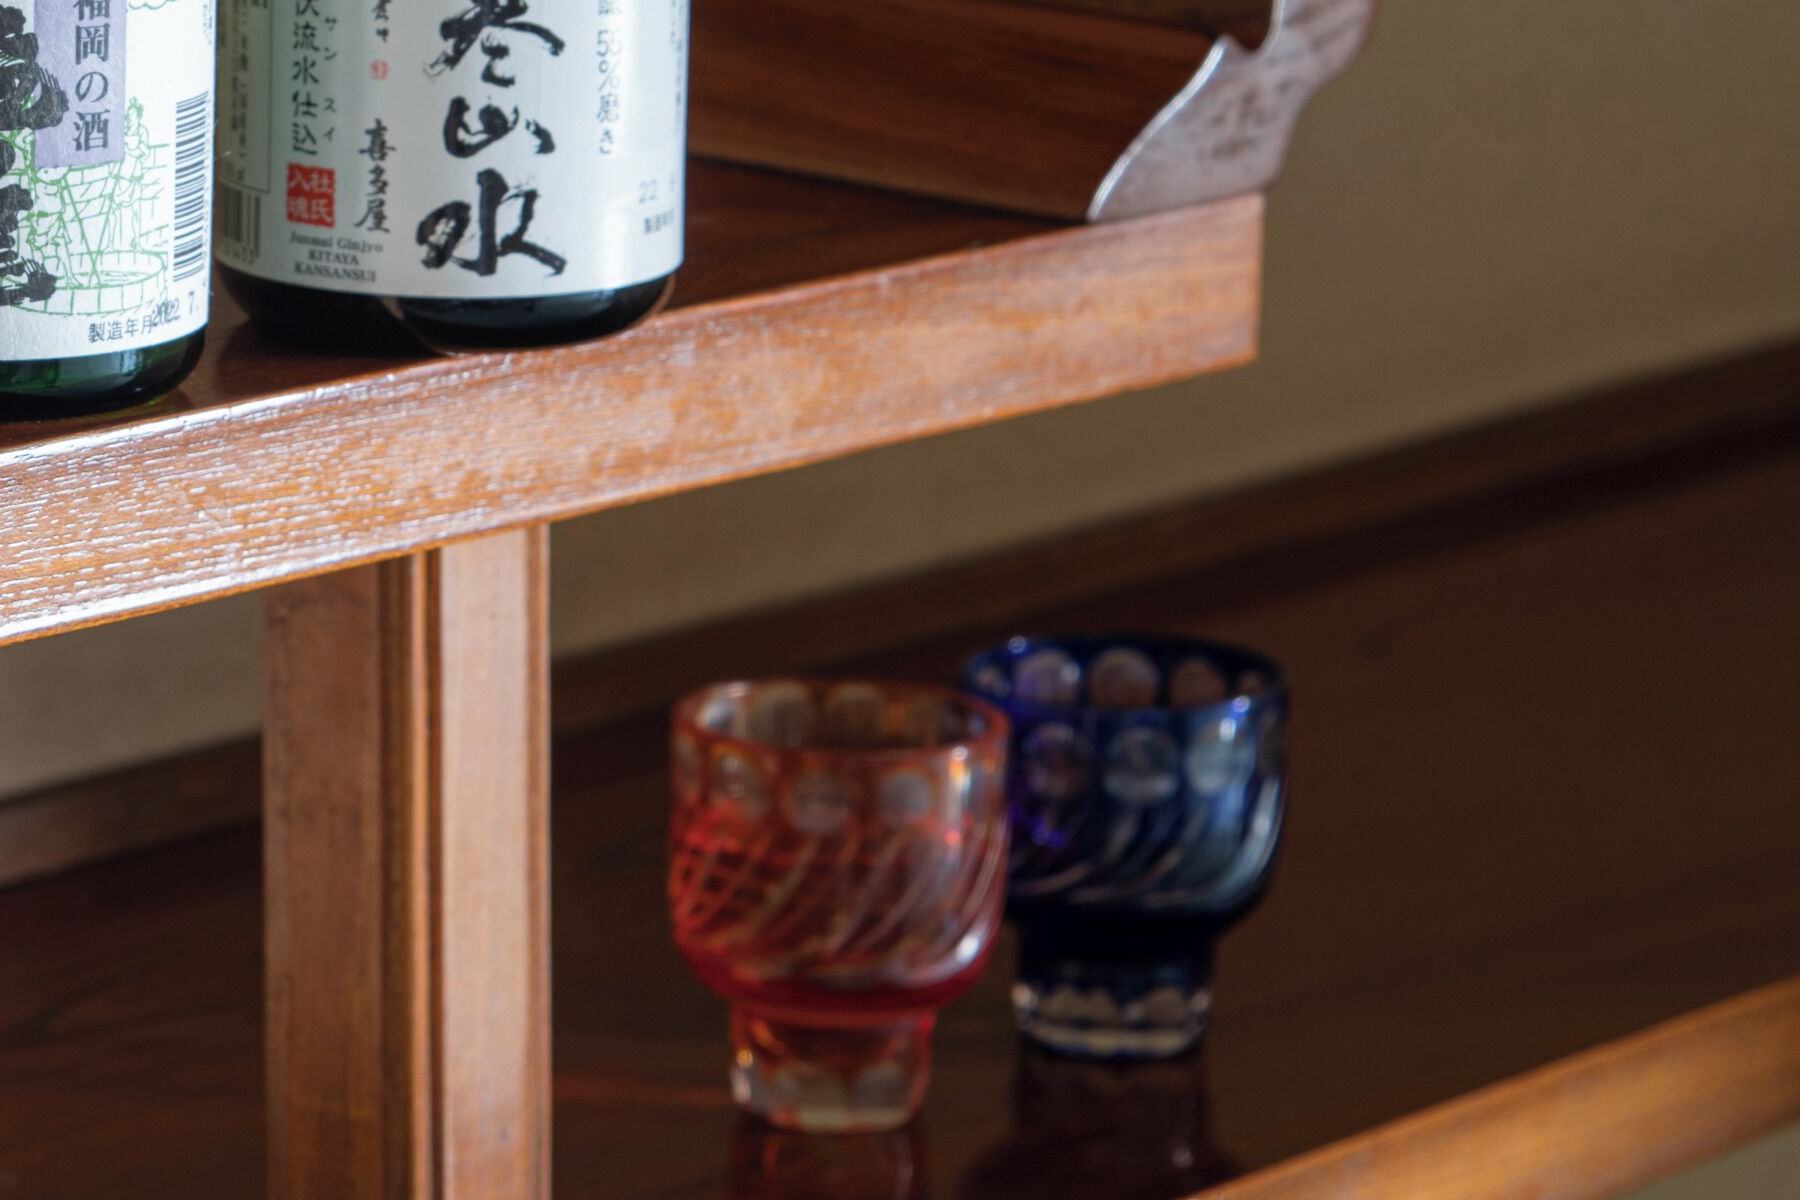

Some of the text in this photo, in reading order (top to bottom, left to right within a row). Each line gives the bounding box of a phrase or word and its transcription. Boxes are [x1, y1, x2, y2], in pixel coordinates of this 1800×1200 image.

[352, 118, 397, 234] 喜多屋
[308, 249, 360, 266] KITAYA
[293, 261, 377, 282] KANSANSUI
[87, 313, 152, 344] 製造年月
